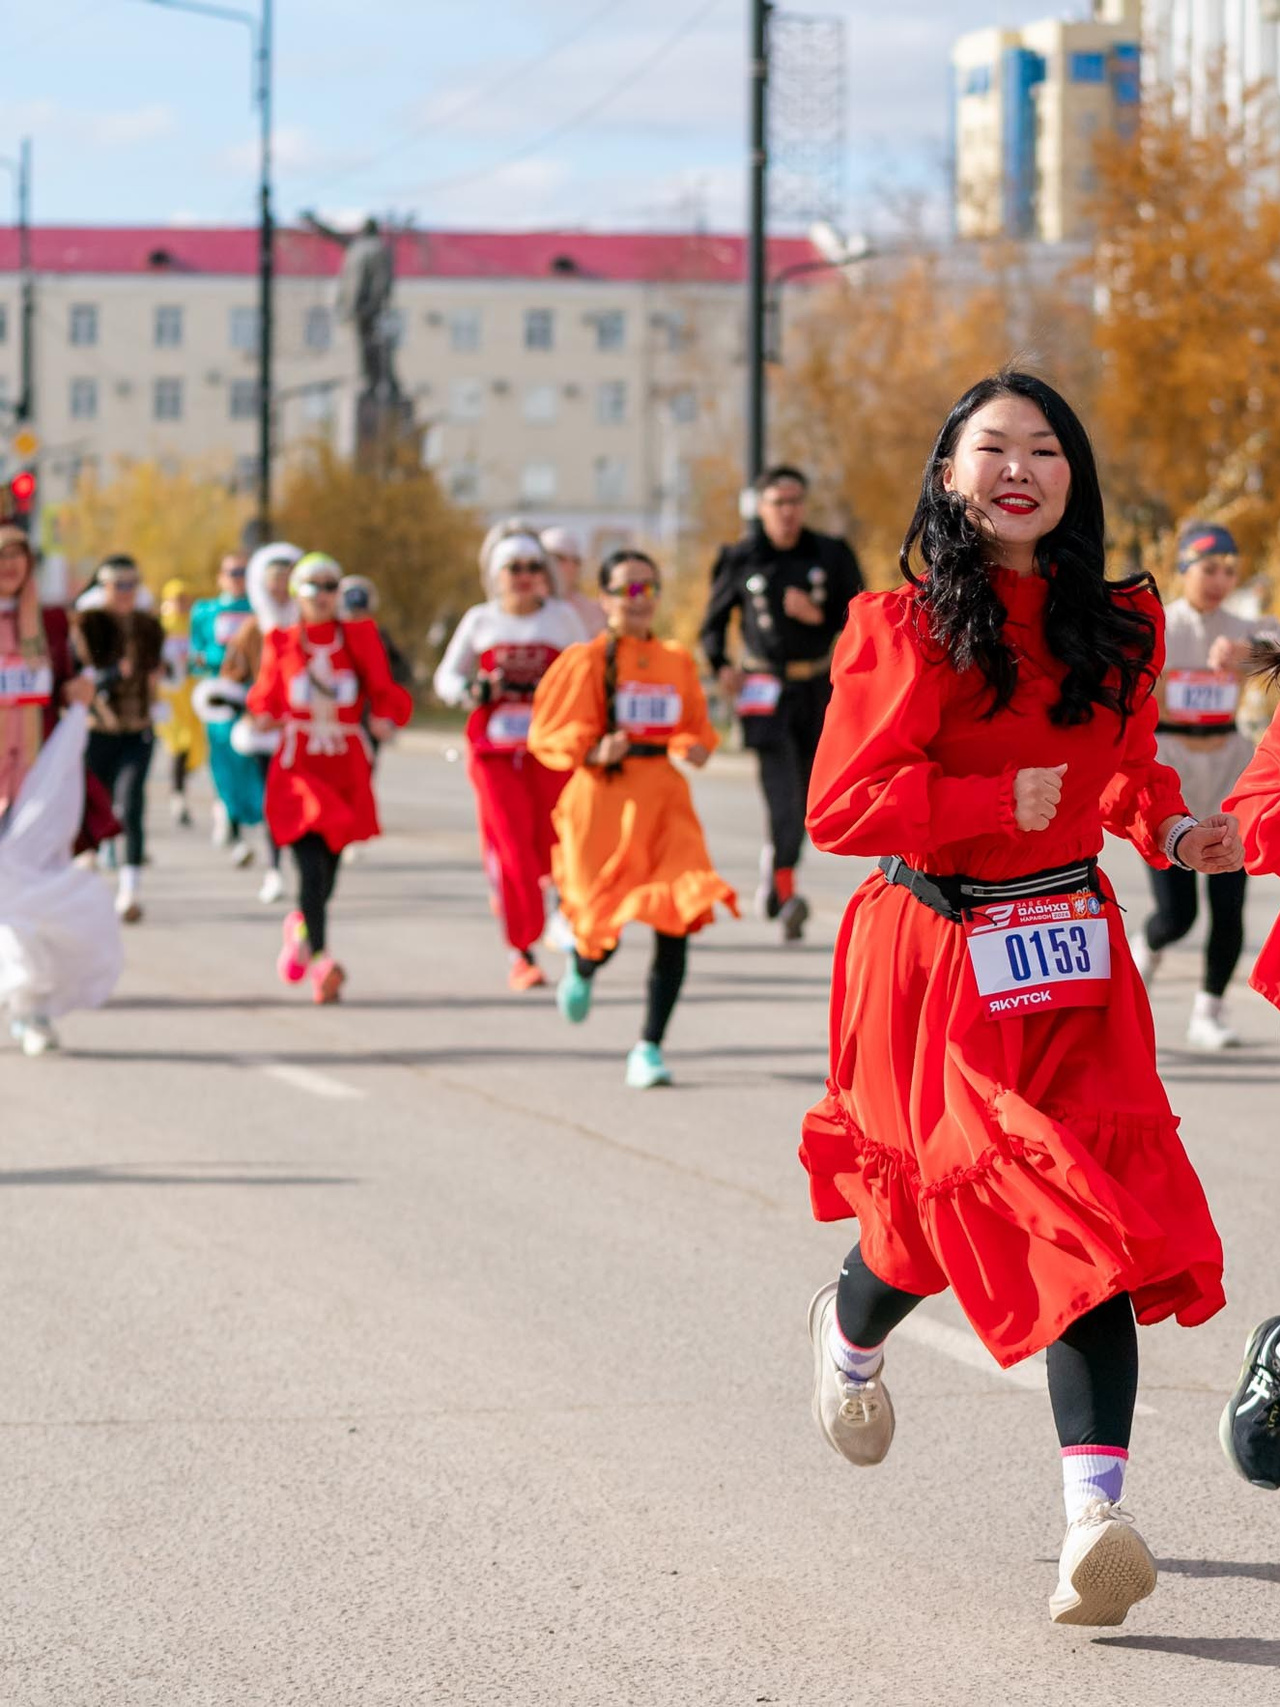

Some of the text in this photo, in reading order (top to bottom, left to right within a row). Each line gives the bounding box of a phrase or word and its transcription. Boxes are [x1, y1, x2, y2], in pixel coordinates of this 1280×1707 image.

[1016, 898, 1051, 909] ЗАБЕГ
[1018, 902, 1069, 916] ОЛОНХО
[1019, 914, 1052, 923] МАРАФОН
[1005, 926, 1091, 982] 0153
[989, 990, 1052, 1012] ЯКУТСК
